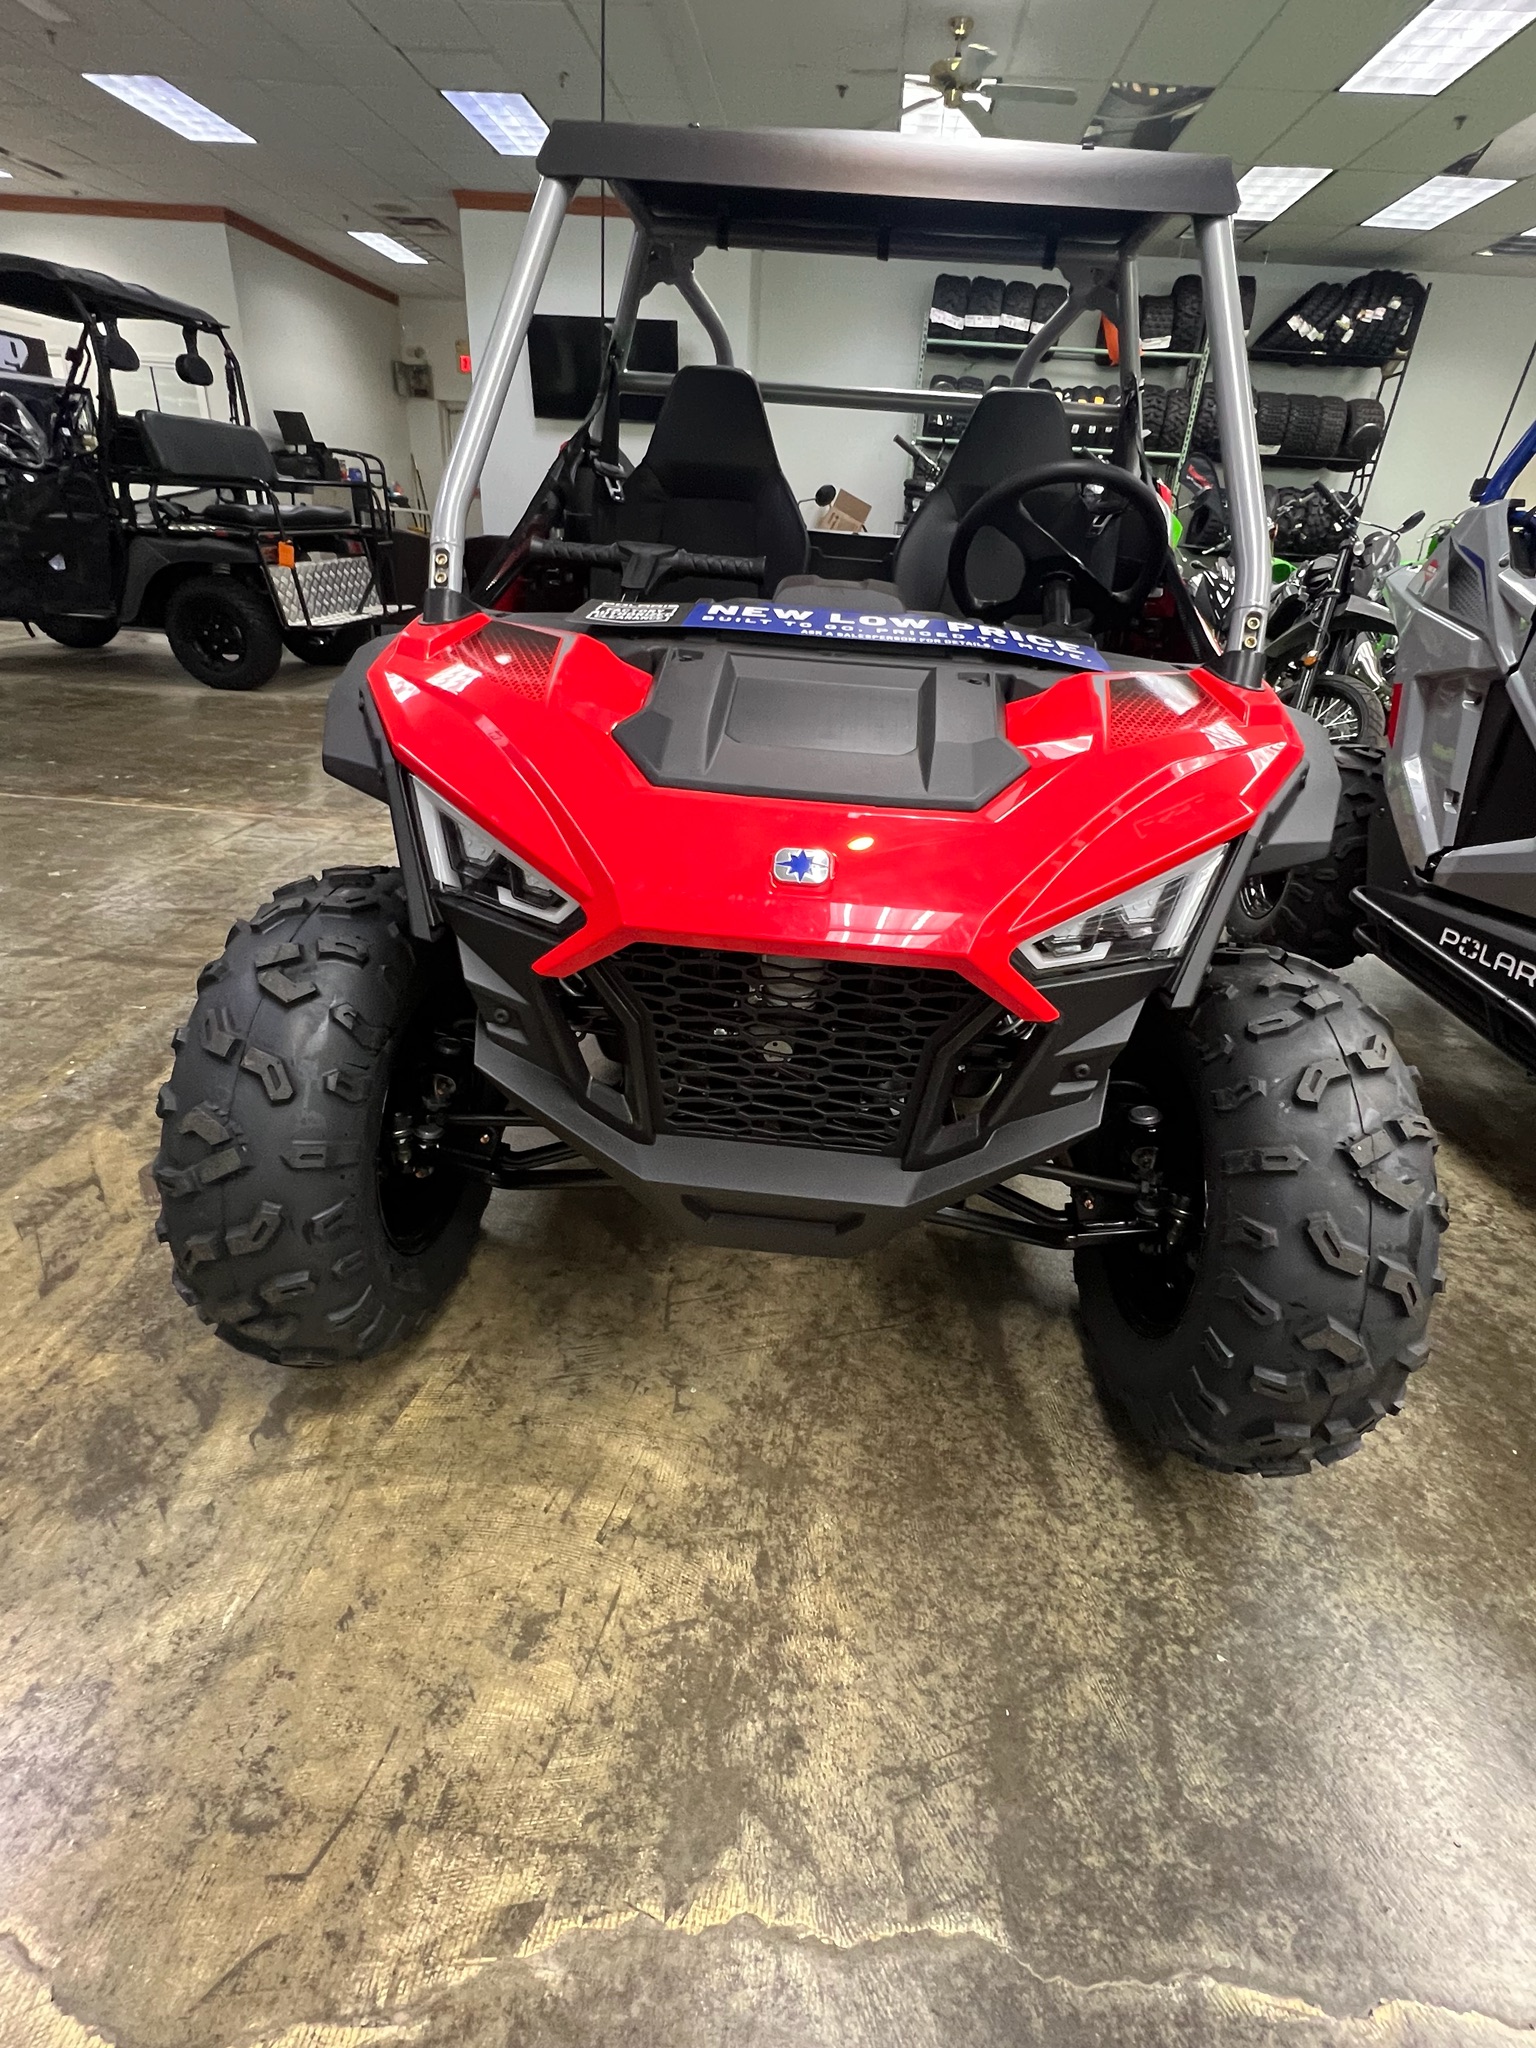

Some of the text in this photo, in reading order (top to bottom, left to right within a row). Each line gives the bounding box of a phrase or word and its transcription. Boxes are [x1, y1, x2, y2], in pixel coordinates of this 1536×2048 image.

[701, 615, 773, 625] BUILT
[784, 620, 813, 628] TO
[876, 628, 966, 640] PRICED
[976, 635, 1007, 645] TO
[1018, 642, 1092, 663] MOVE.
[707, 604, 1086, 656] NEW LOW PRICE
